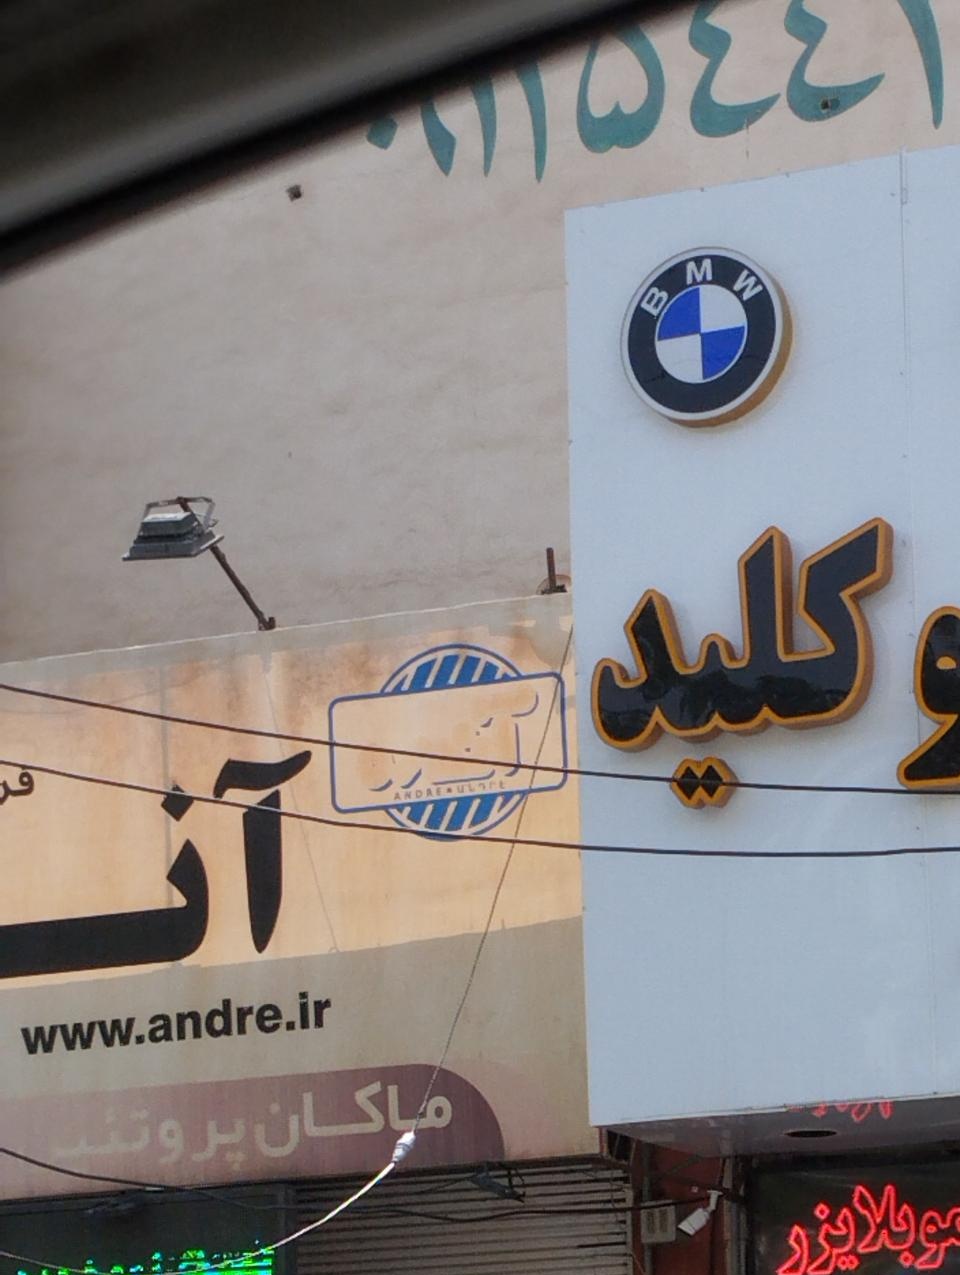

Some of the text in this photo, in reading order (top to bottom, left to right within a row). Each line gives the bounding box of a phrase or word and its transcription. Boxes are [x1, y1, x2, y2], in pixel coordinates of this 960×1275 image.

[640, 258, 763, 317] BMW
[591, 516, 895, 809] کلید
[21, 991, 332, 1056] www.andre.ir
[255, 1081, 453, 1158] ماکان
